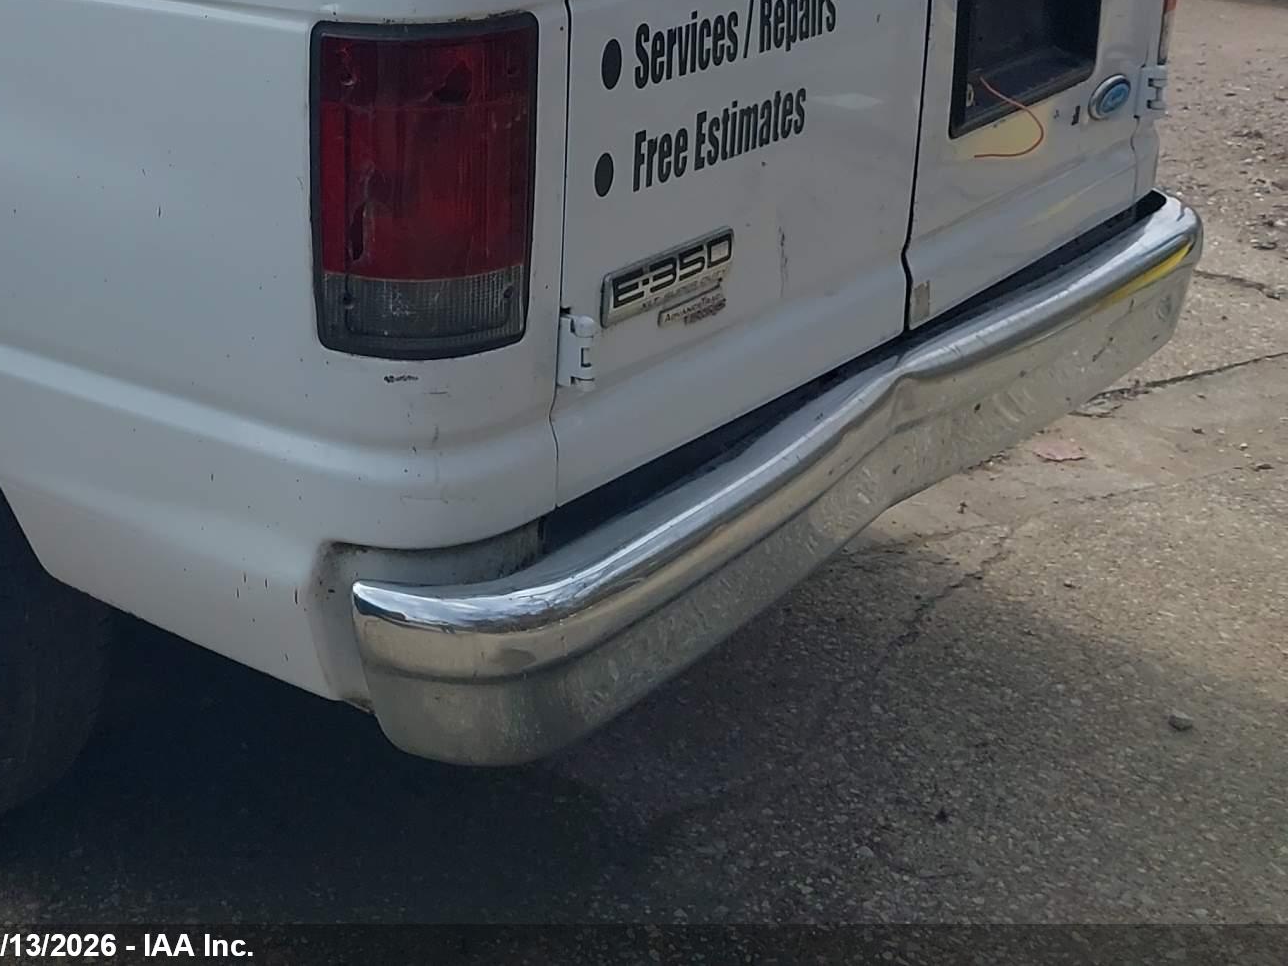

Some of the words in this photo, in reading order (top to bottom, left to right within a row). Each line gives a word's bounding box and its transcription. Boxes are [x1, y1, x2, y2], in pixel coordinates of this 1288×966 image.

[634, 10, 739, 89] Services
[633, 128, 688, 192] Free
[694, 88, 806, 171] Estimates
[612, 233, 732, 309] E-350
